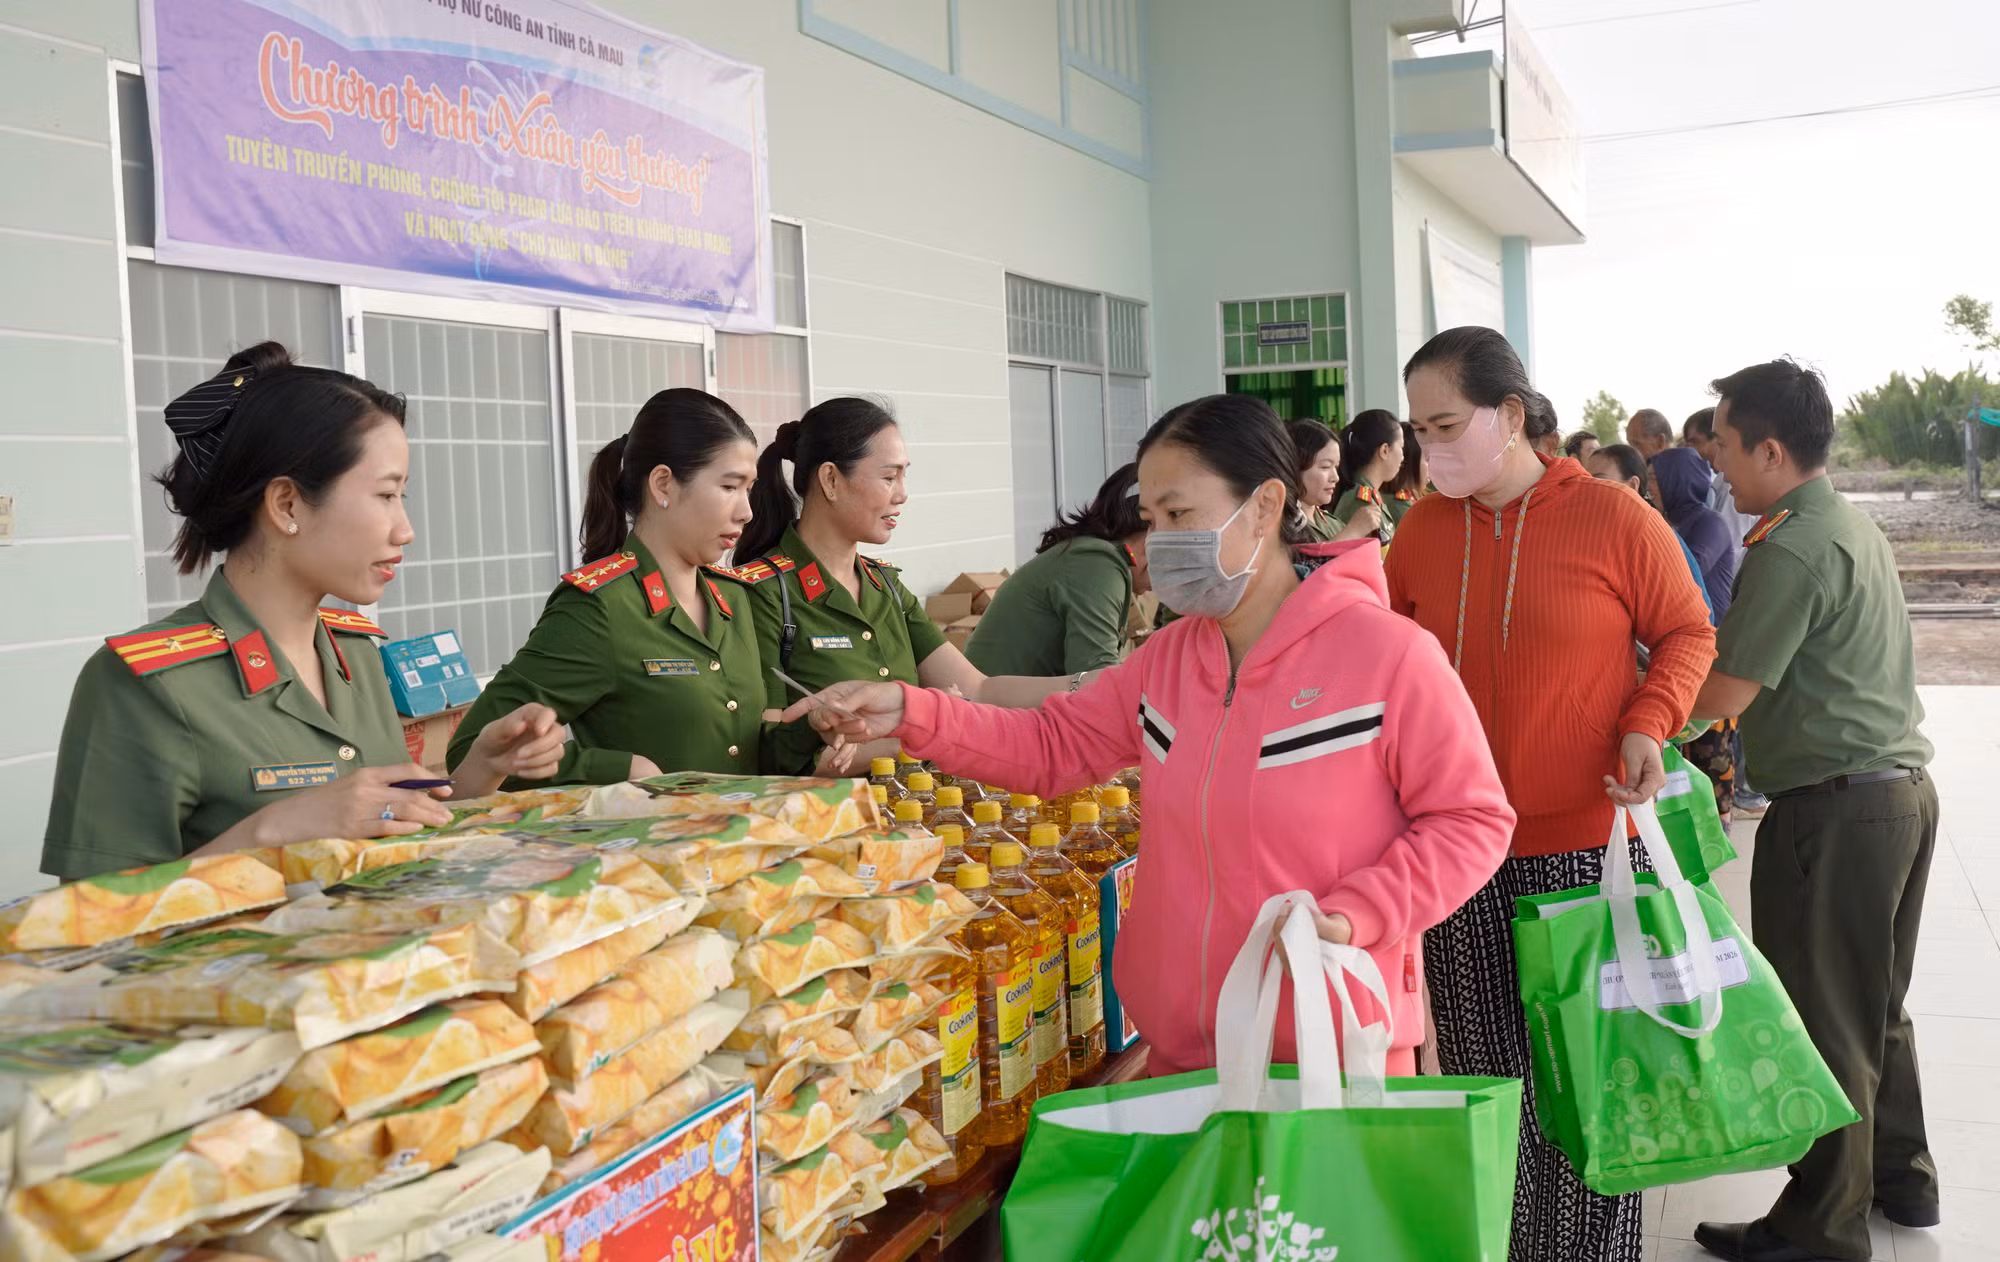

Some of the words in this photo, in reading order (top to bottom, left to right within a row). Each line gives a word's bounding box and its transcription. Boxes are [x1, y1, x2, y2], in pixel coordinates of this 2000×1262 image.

[485, 3, 522, 32] CÔNG
[526, 18, 544, 40] AN
[547, 22, 576, 50] TỈNH
[598, 42, 625, 66] MAU
[259, 31, 400, 149] Chương
[401, 75, 484, 145] trình
[581, 129, 641, 207] yêu
[225, 135, 288, 172] TUYÊN
[292, 147, 363, 185] TRUYỀN
[367, 161, 428, 199] PHÒNG,
[430, 174, 481, 208] CHỐNG
[482, 184, 506, 216] TỘI
[603, 210, 635, 237] TRÊN
[404, 207, 426, 238] VÀ
[429, 214, 466, 248] HOẠT
[469, 218, 509, 252] ĐỘNG
[547, 234, 581, 262] XUÂN
[1298, 688, 1322, 699] NIKE
[1724, 950, 1739, 961] 2026
